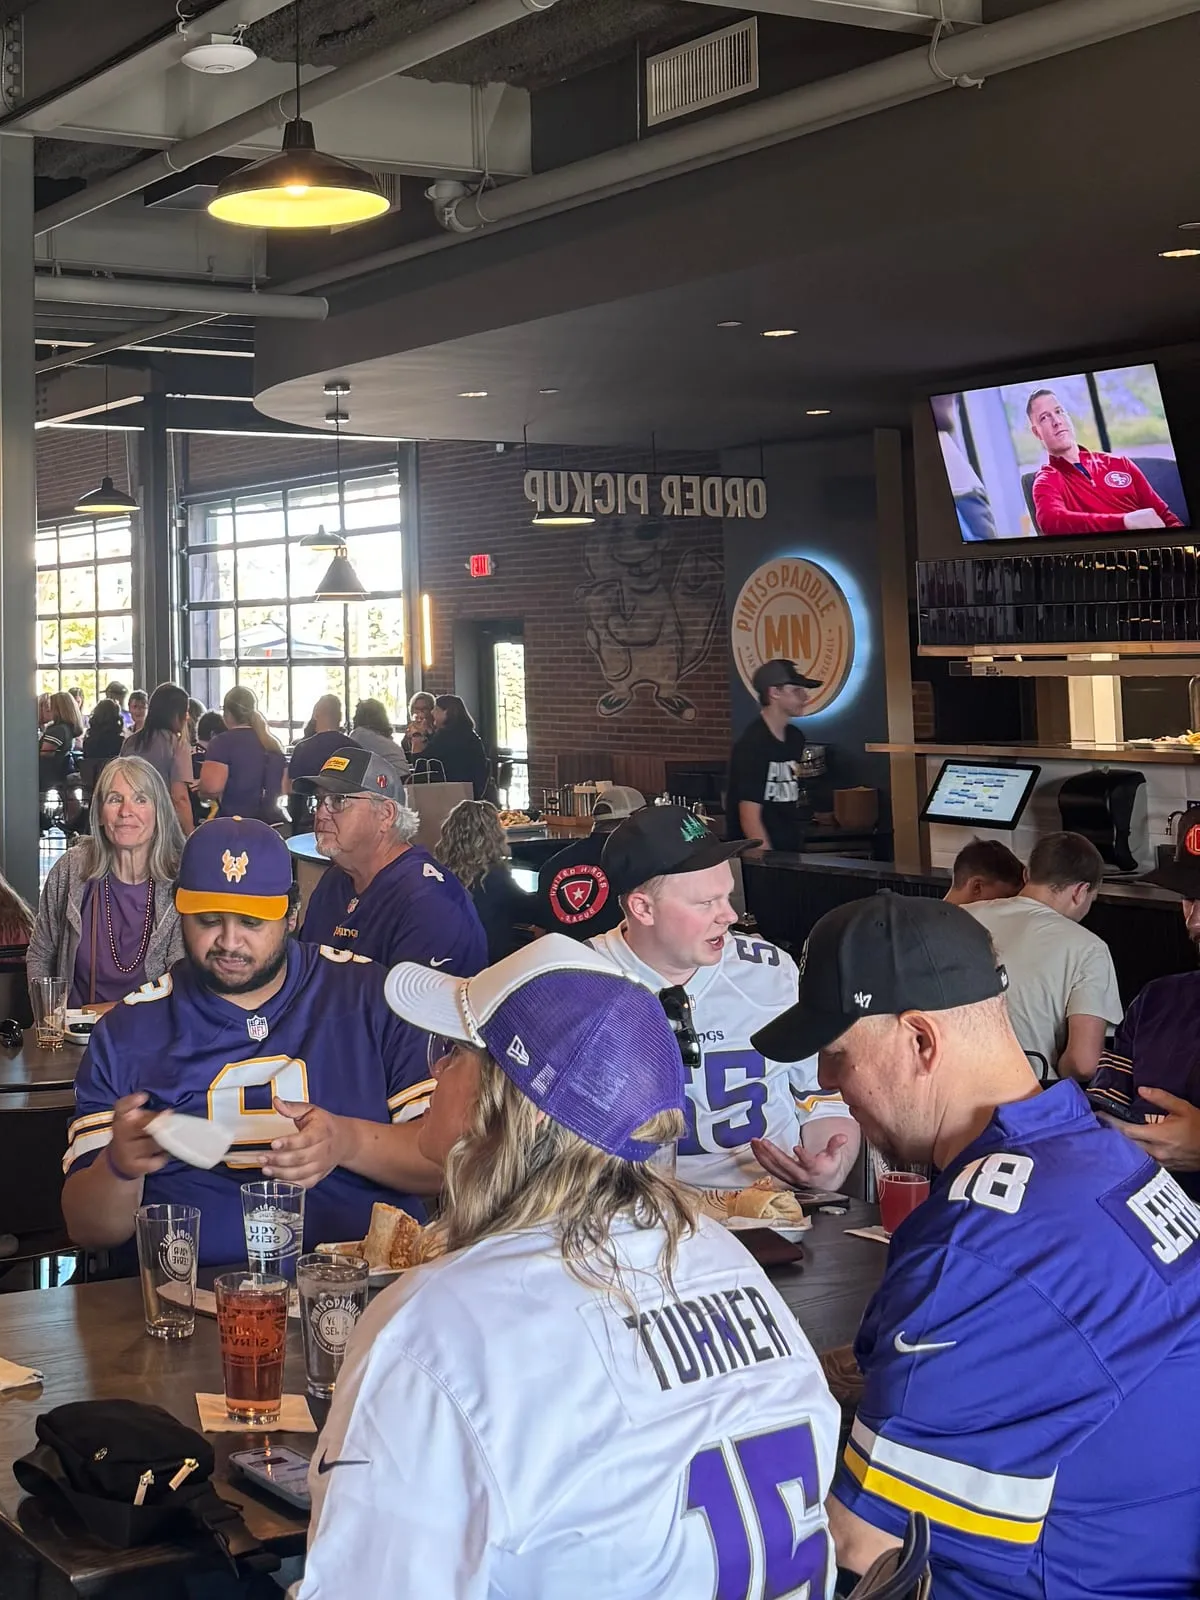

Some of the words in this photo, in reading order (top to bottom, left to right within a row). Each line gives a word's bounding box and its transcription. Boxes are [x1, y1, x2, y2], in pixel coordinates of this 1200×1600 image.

[736, 576, 769, 633] PINTS
[780, 564, 837, 619] PADDLE
[764, 613, 812, 660] MN
[947, 1152, 1035, 1216] 18
[621, 1286, 793, 1392] TURNER
[680, 1414, 836, 1600] 15
